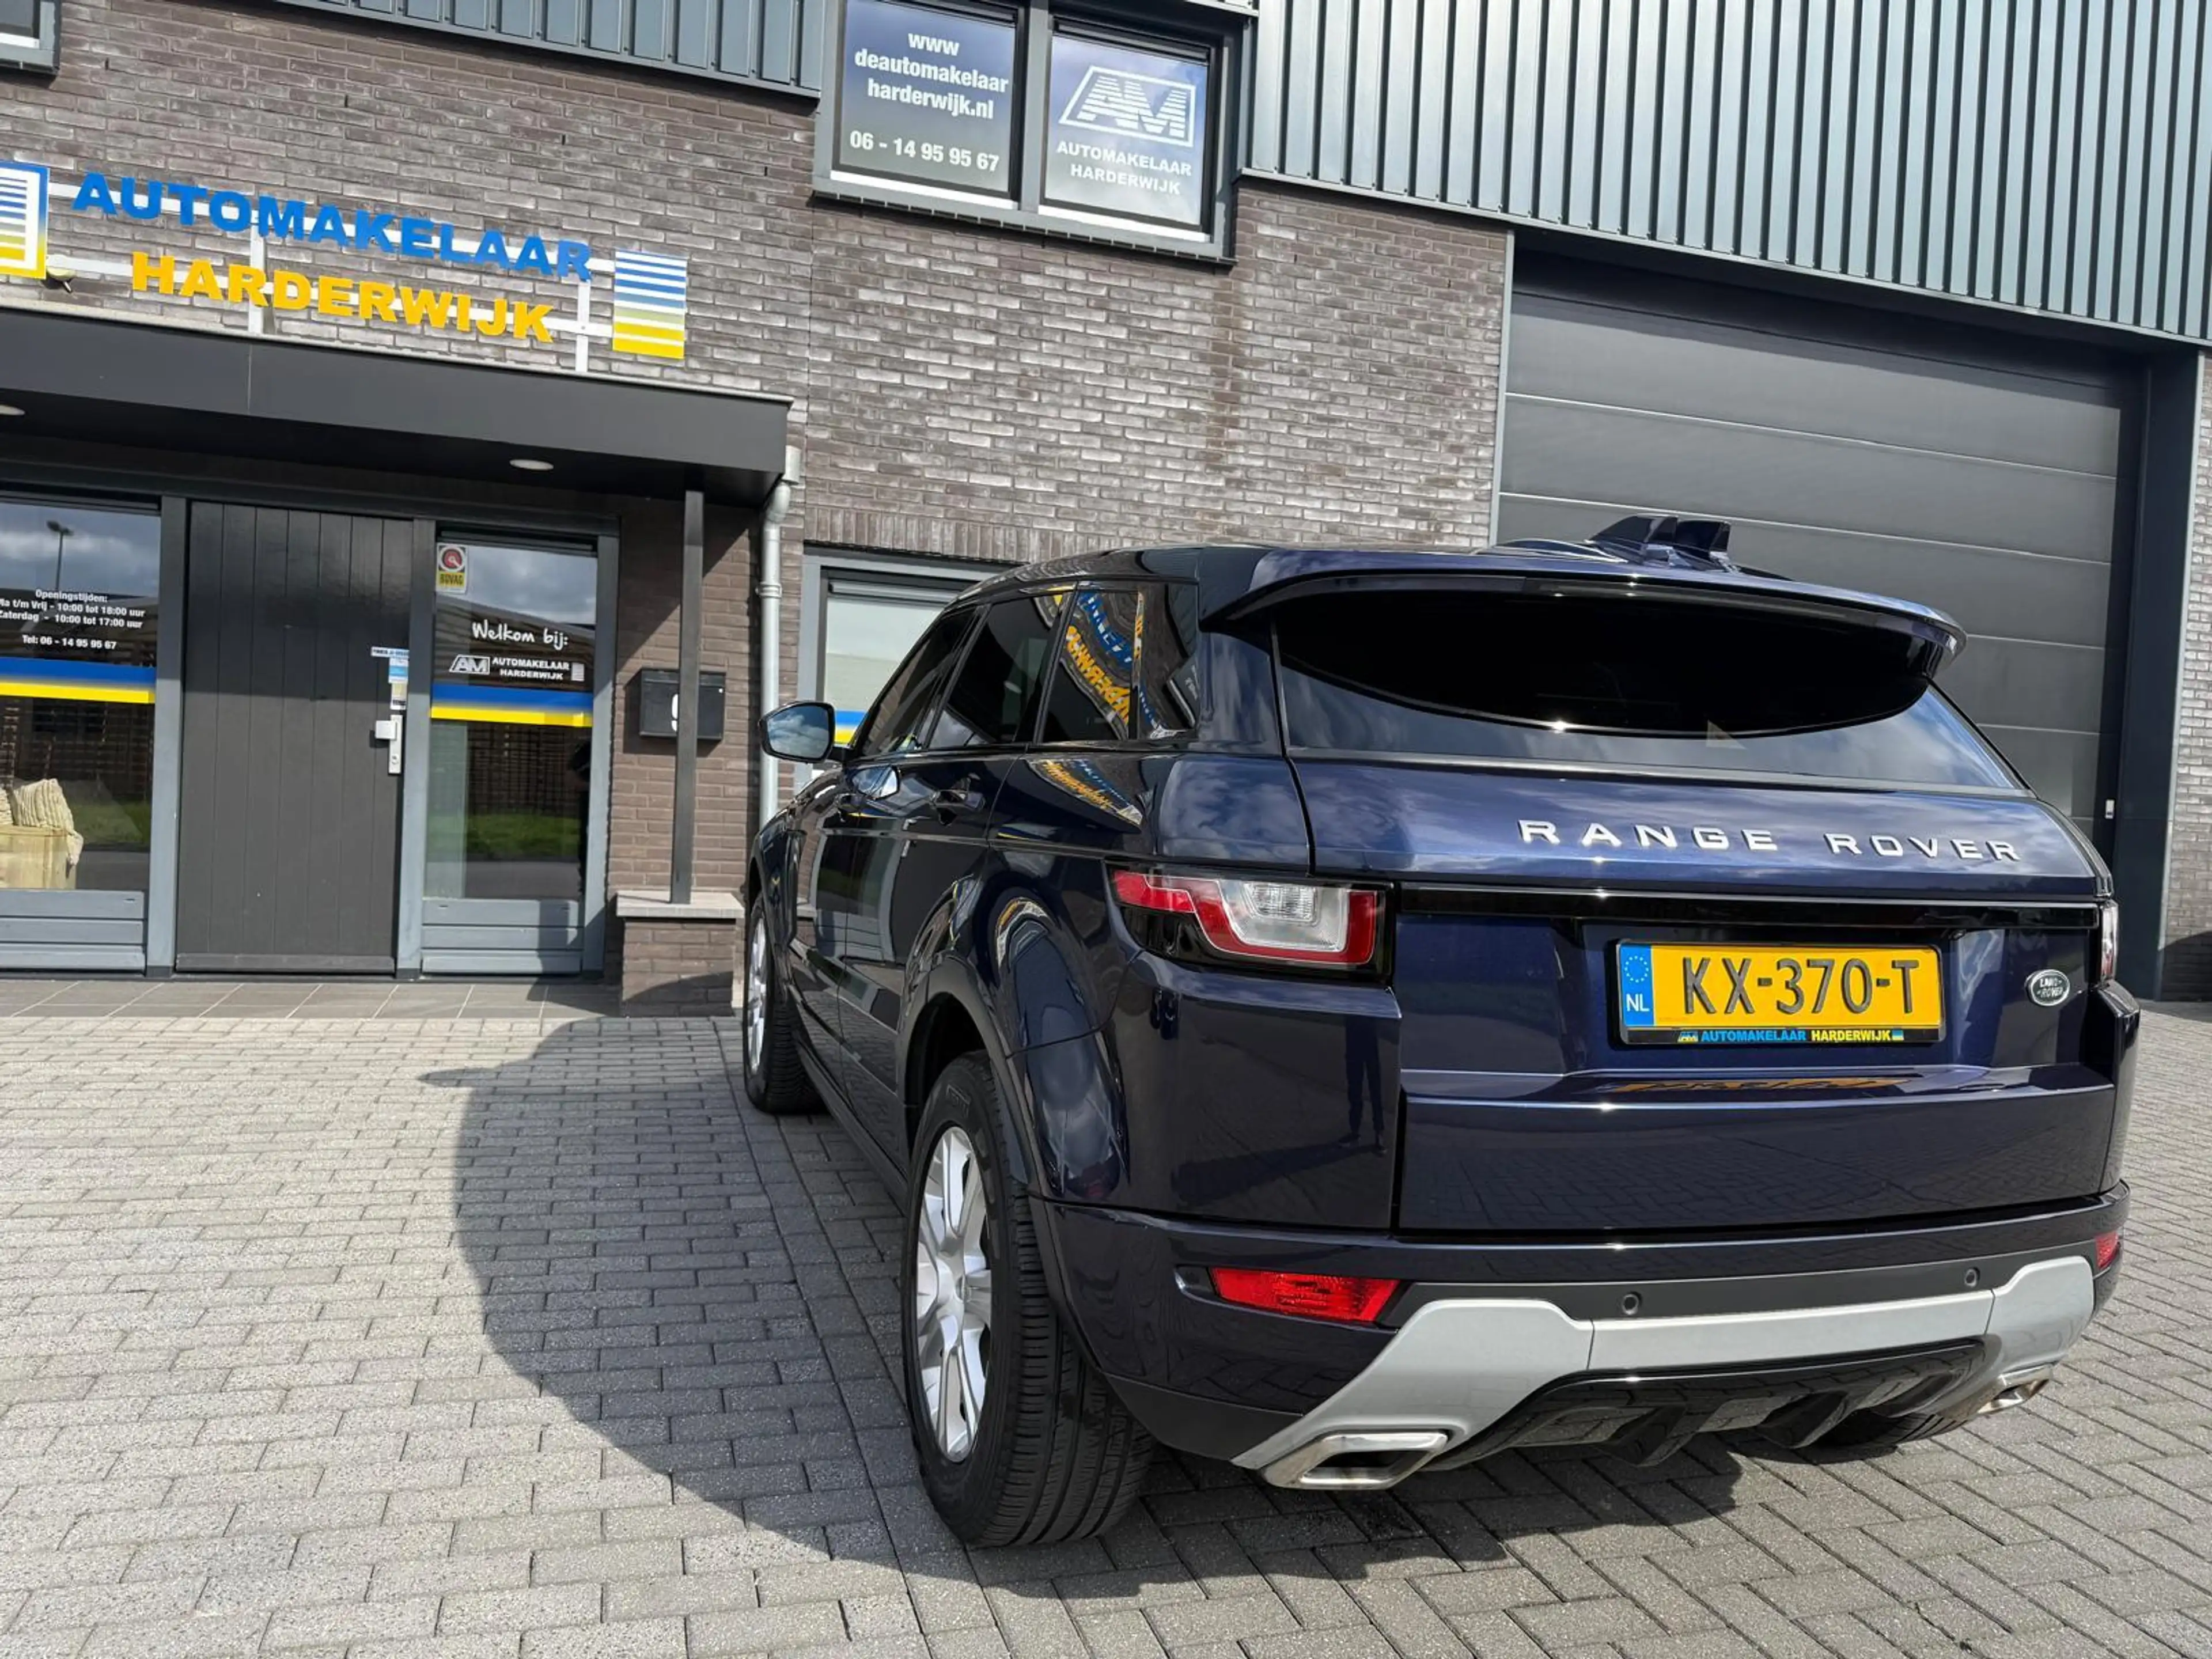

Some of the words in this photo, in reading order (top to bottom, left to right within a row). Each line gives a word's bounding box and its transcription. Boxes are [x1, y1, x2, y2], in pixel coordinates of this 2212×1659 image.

[908, 33, 960, 56] www
[855, 48, 1009, 94] deautomakelaar
[868, 78, 994, 120] harderwijk.nl
[850, 131, 874, 151] 06
[893, 138, 916, 158] 14
[921, 142, 944, 163] 95
[949, 146, 972, 168] 95
[976, 152, 999, 172] 67
[1056, 140, 1192, 177] AUTOMAKELAAR
[1070, 164, 1181, 195] HARDERWIJK
[72, 171, 592, 282] AUTOMAKELAAR
[132, 251, 555, 343] HARDERWIJK
[31, 600, 47, 611] Vrij
[58, 603, 83, 613] 10:00
[86, 605, 99, 614] tot
[101, 606, 127, 616] 18:00
[129, 609, 145, 618] uur
[35, 589, 108, 603] Openingstijden:
[55, 613, 81, 624] 10:00
[83, 616, 96, 625] tot
[99, 617, 124, 627] 17:00
[127, 619, 143, 628] uur
[472, 619, 535, 643] Welkom
[543, 628, 569, 650] bij:
[22, 634, 39, 645] Tel:
[40, 636, 52, 645] 06
[62, 638, 74, 647] 14
[76, 638, 88, 647] 95
[90, 640, 102, 649] 95
[104, 641, 117, 650] 67
[493, 657, 569, 671] AUTOMAKELAAR
[499, 668, 563, 680] HARDERWIJK
[1517, 819, 1778, 851] RANGE
[1823, 832, 2021, 861] ROVER
[1682, 956, 1920, 1014] KX-370-T
[1626, 993, 1650, 1012] NL
[1701, 1029, 1807, 1042] AUTOMAKELAAR
[1811, 1029, 1891, 1042] HARDERWIJK
